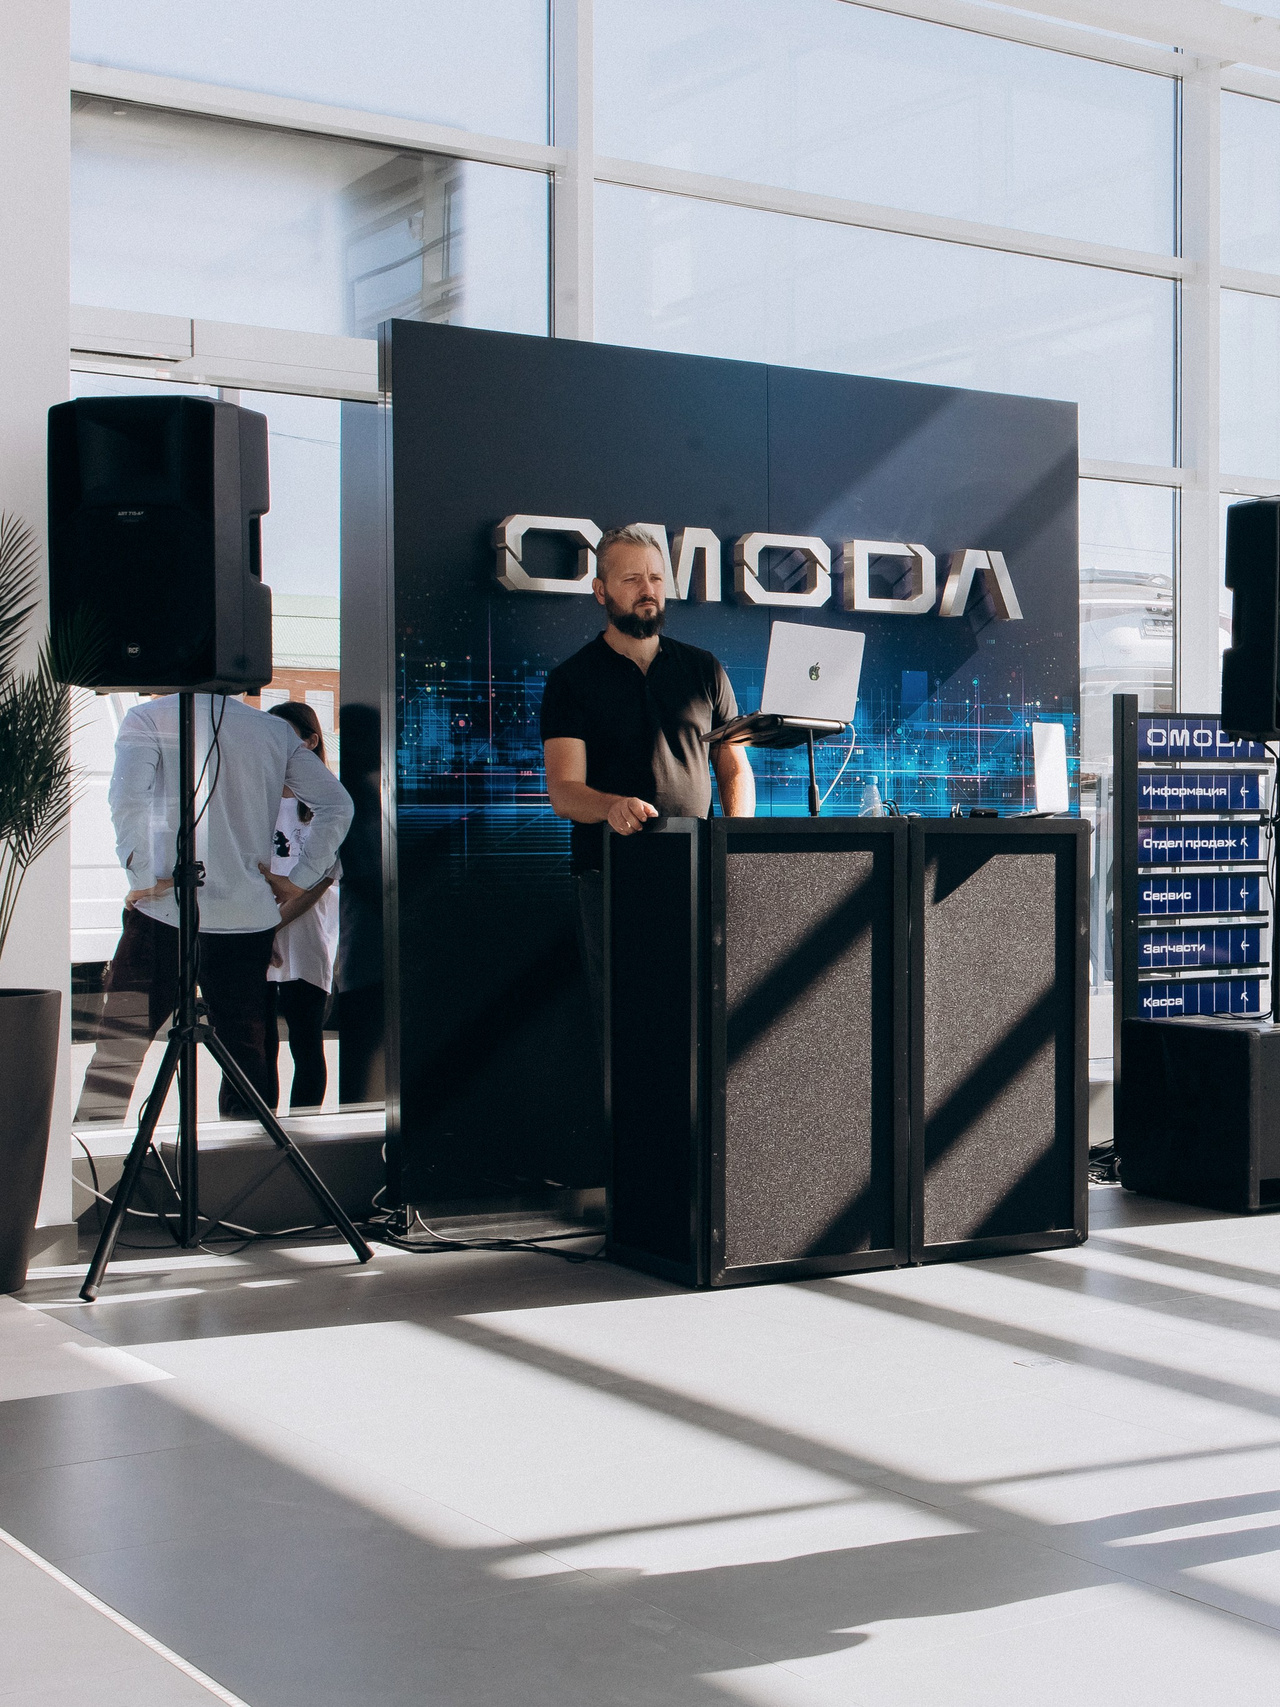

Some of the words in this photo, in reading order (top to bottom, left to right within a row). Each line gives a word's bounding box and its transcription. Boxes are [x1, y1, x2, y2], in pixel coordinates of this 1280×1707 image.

[496, 514, 1024, 620] OMODA
[1142, 786, 1227, 798] Информация
[1143, 839, 1183, 850] Отдел
[1185, 839, 1237, 850] продаж
[1143, 891, 1192, 902] Сервис
[1143, 944, 1206, 954] Запчасти
[1143, 998, 1183, 1007] Касса
